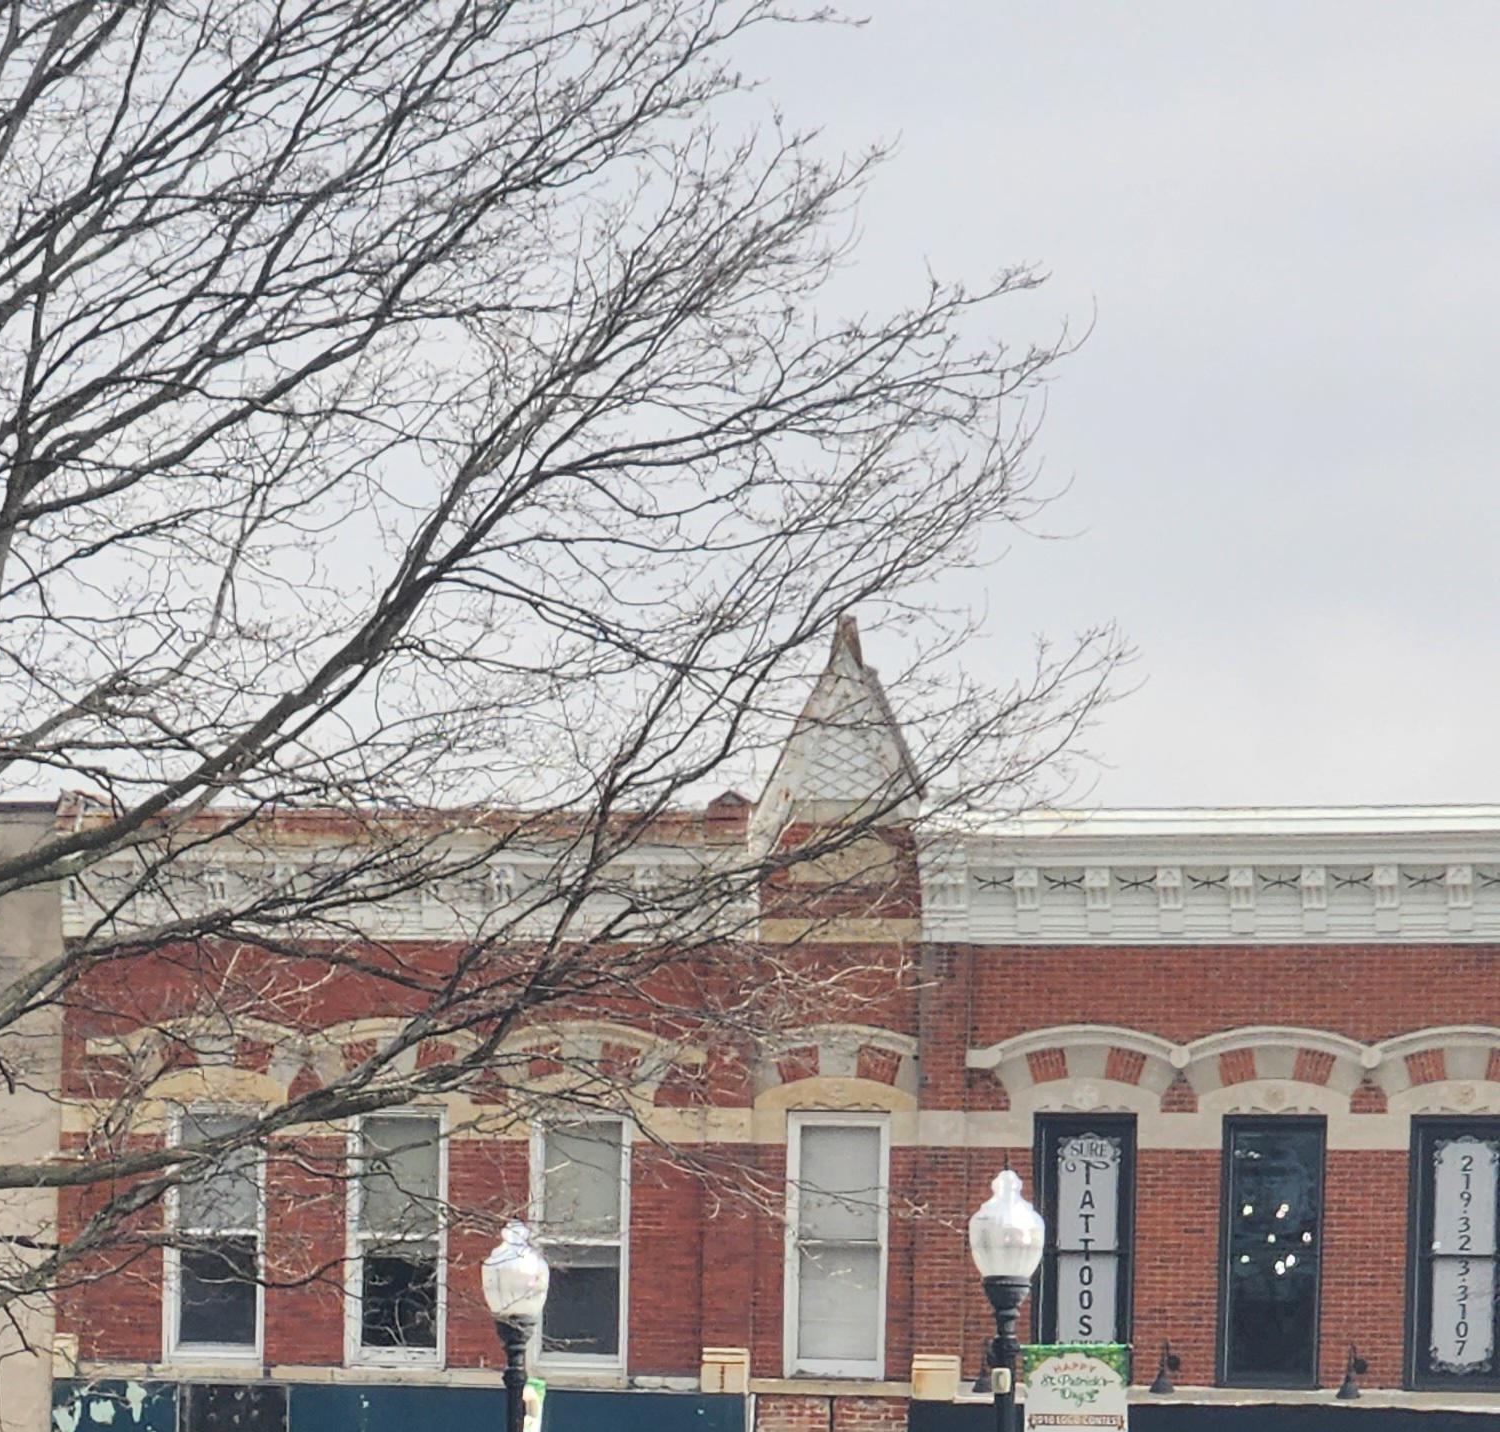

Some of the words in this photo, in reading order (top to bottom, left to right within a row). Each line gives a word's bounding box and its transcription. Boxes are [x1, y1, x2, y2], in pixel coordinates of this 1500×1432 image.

[1070, 1142, 1108, 1158] SURE
[1065, 1160, 1110, 1337] TATTOOS
[1053, 1362, 1096, 1374] HAPPY
